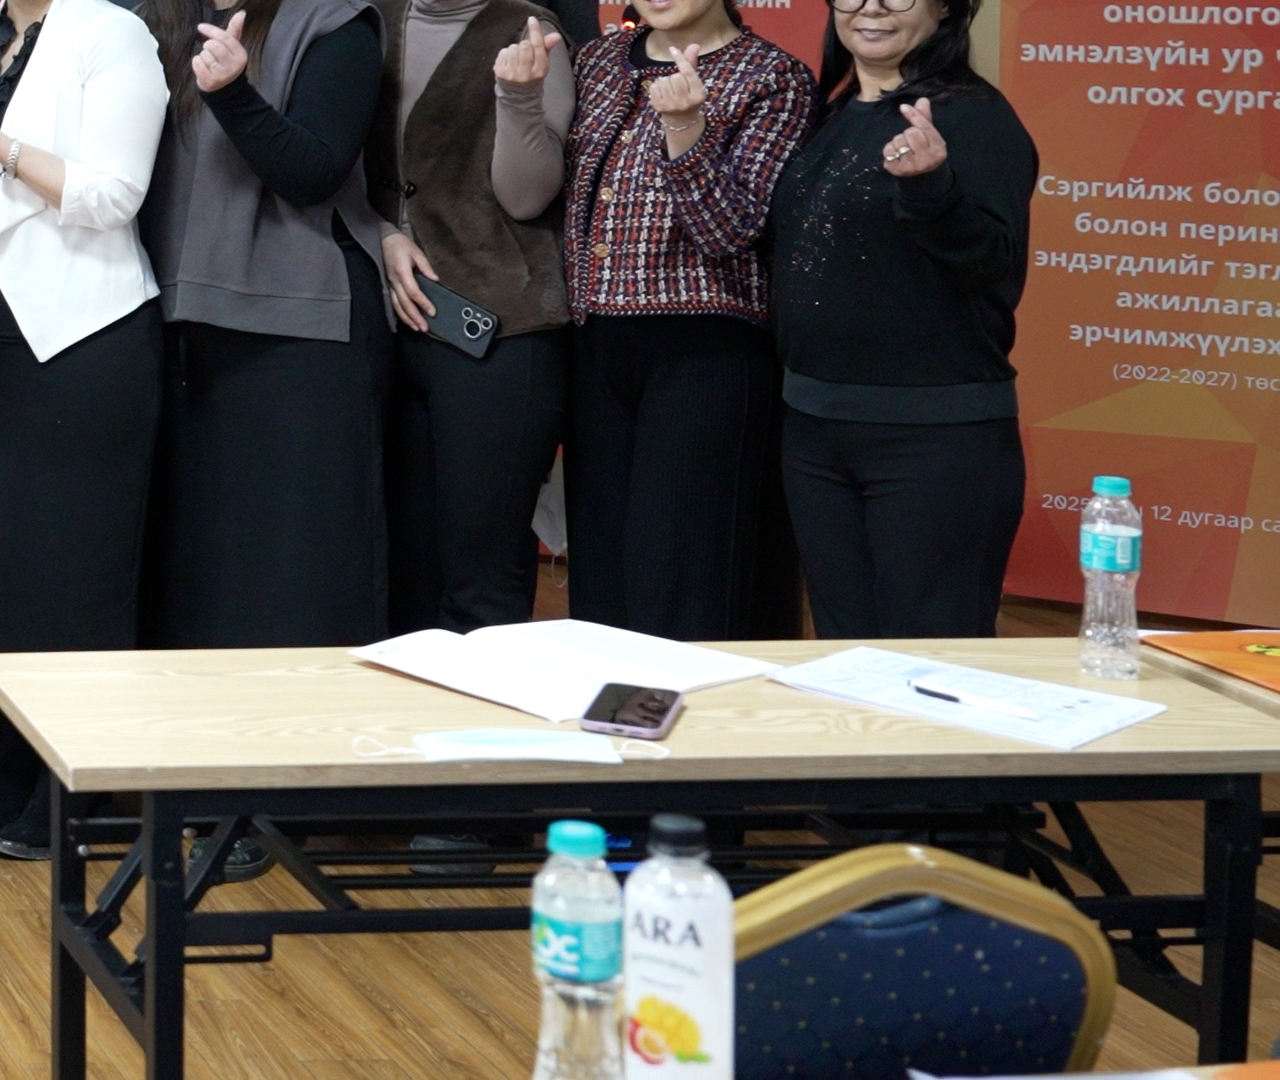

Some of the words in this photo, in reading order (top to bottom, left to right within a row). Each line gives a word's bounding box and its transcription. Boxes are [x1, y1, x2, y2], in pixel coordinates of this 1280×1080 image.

[1020, 40, 1210, 71] эмнэлзүйн
[1221, 47, 1264, 74] ур
[1087, 85, 1185, 107] олгох
[1038, 175, 1193, 202] Сэргийлж
[1074, 212, 1167, 237] болон
[1180, 222, 1280, 247] перин
[1034, 250, 1214, 277] эндэгдлийг
[1113, 363, 1238, 390] (2022-2027)
[1151, 505, 1172, 521] 12
[1178, 510, 1254, 534] дугаар
